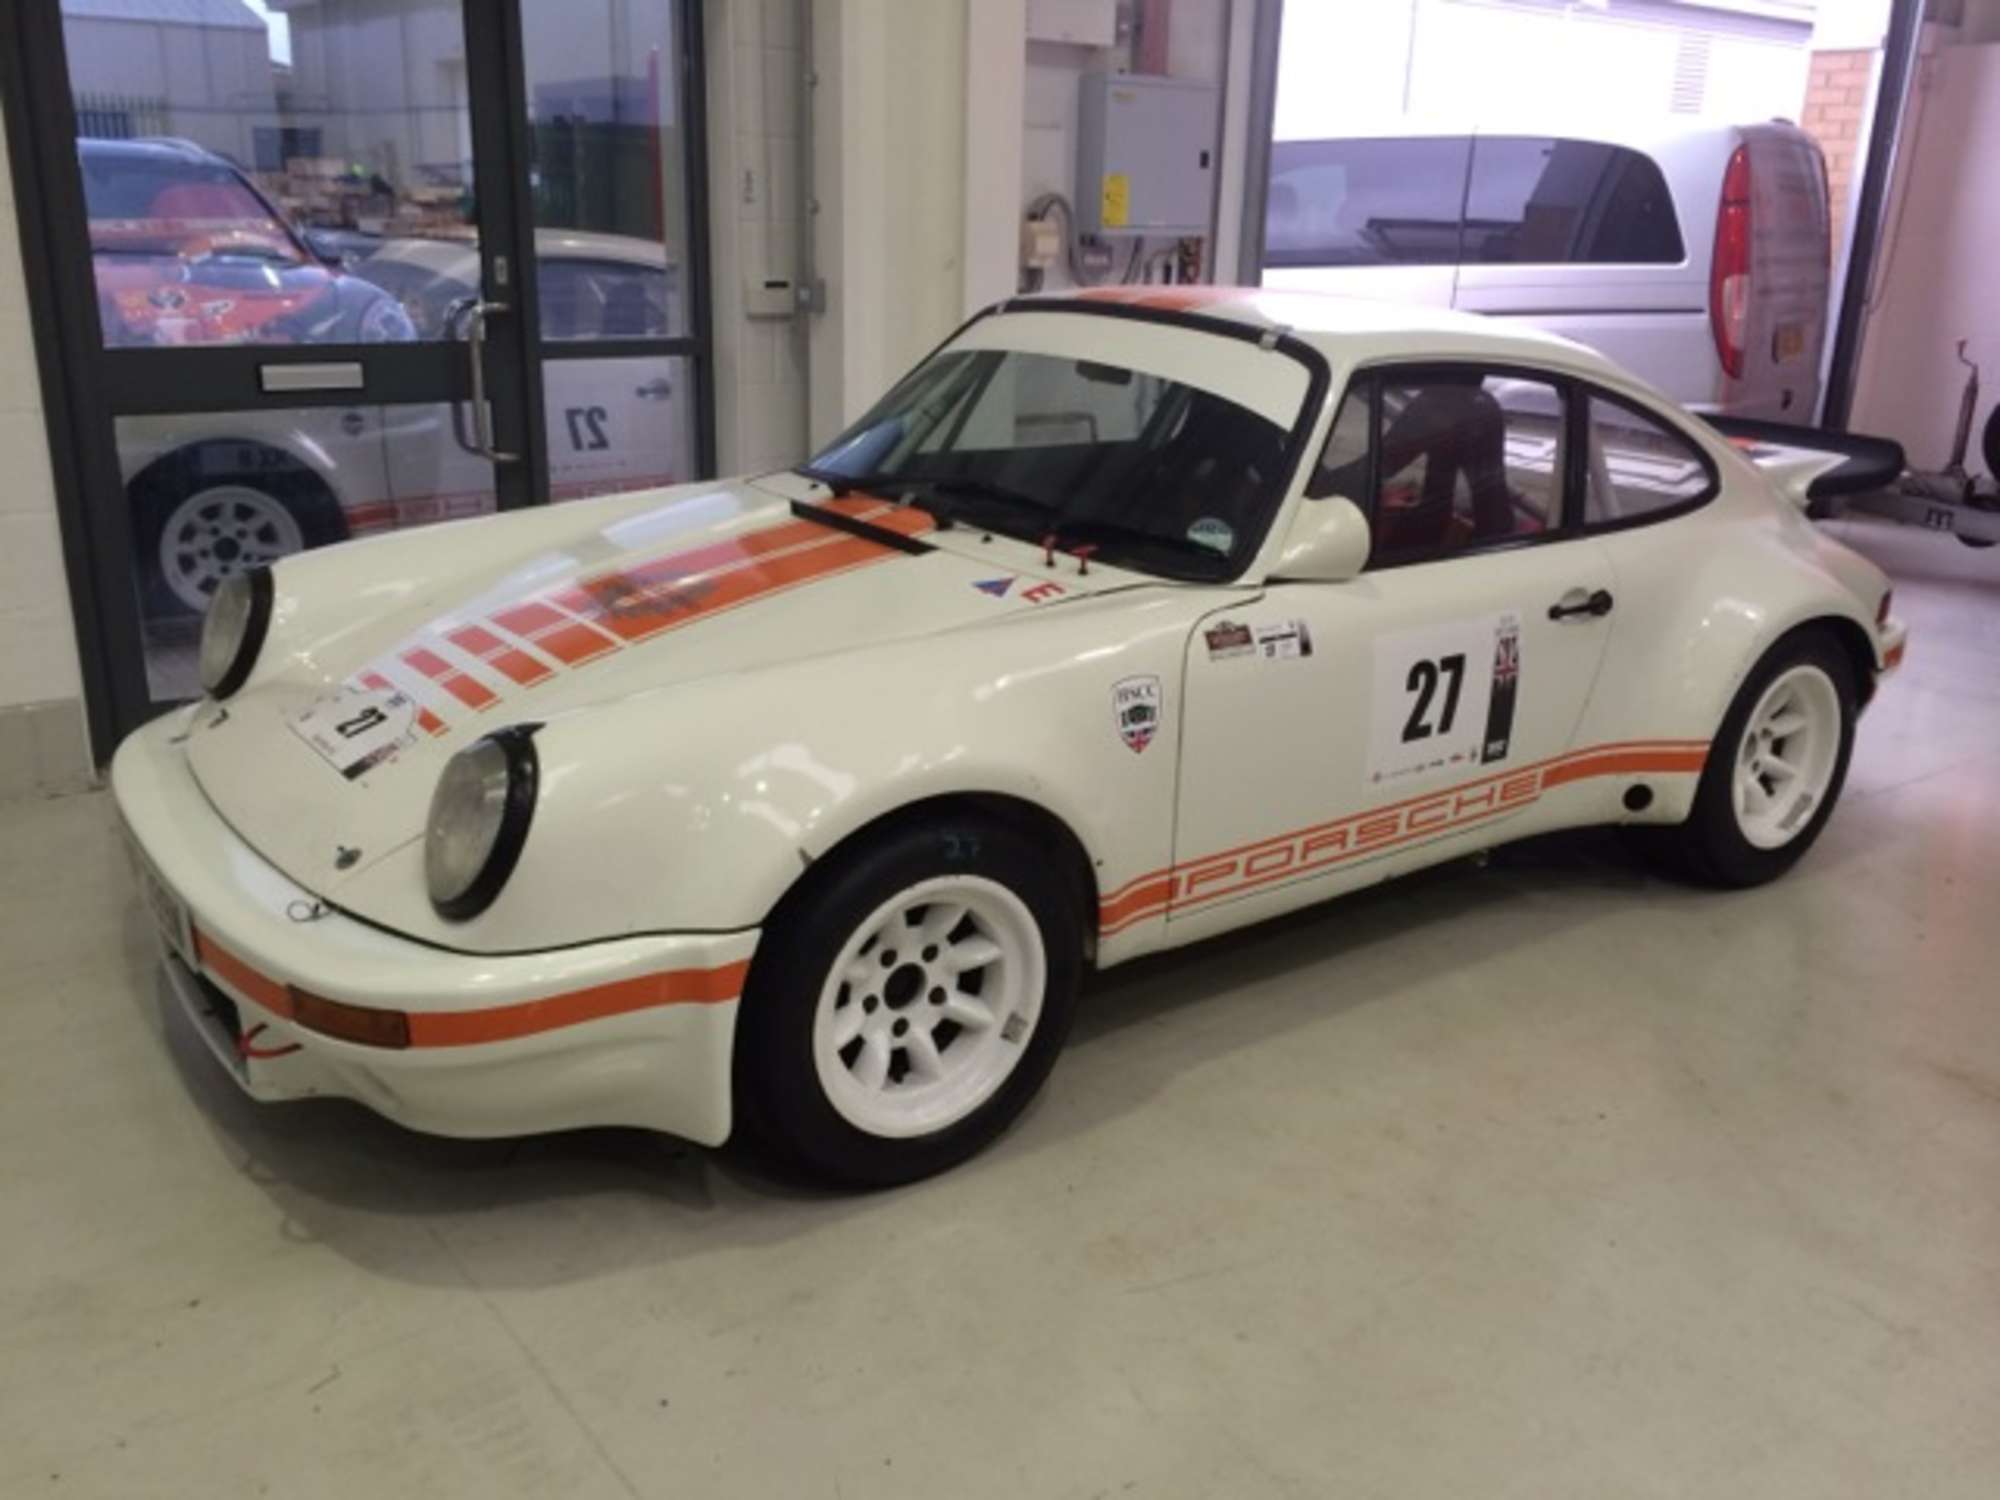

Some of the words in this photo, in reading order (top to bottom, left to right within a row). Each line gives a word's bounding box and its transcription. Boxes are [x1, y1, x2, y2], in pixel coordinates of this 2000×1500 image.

[335, 706, 388, 738] 27
[1402, 653, 1467, 743] 27
[1186, 772, 1539, 895] PORSCHE
